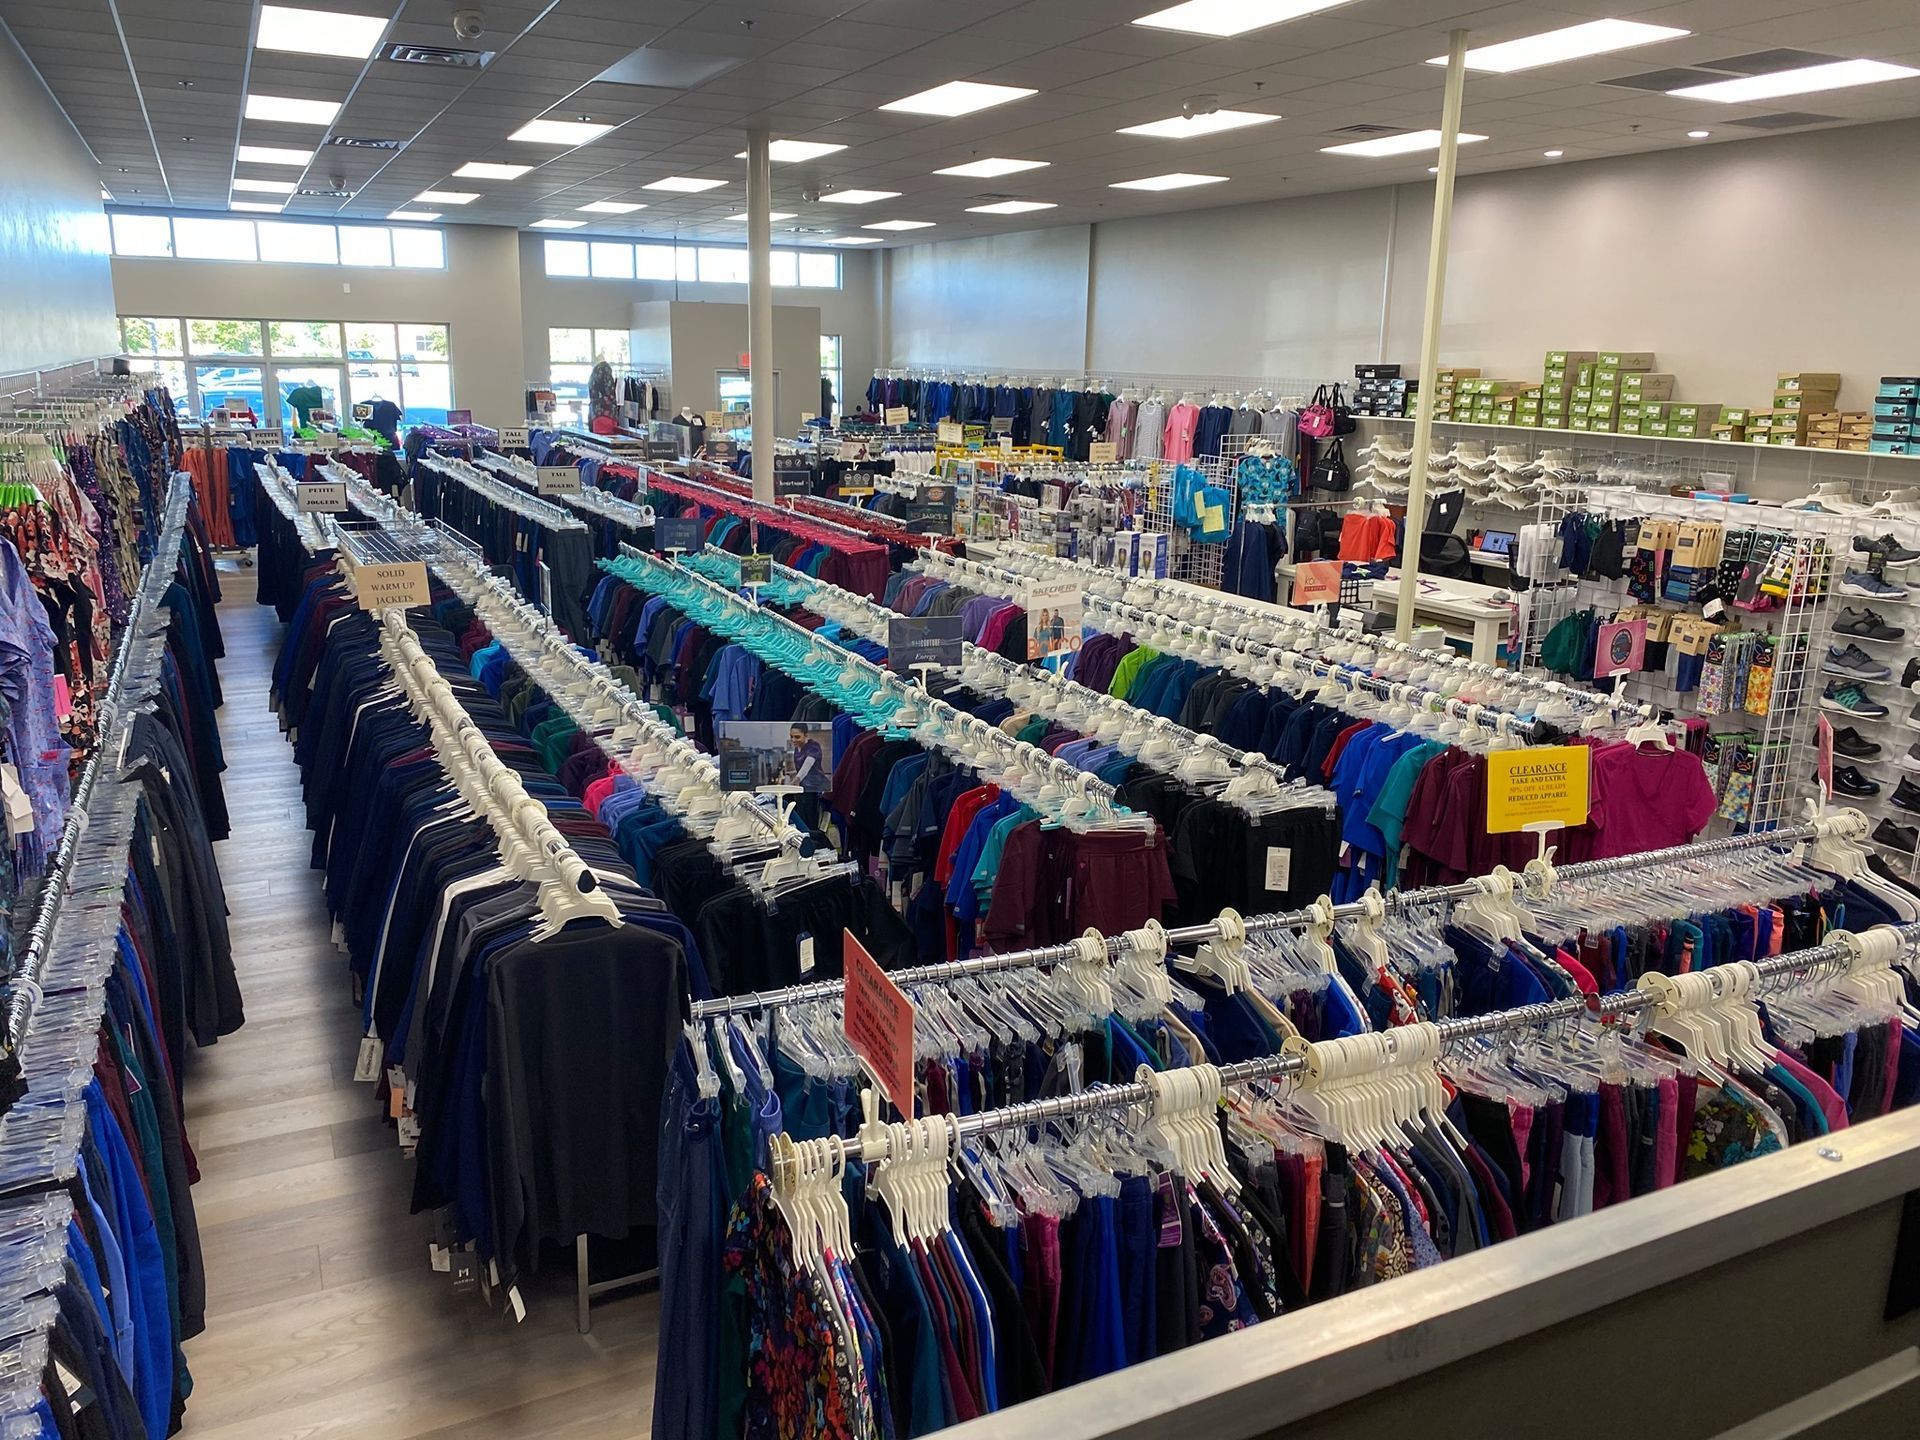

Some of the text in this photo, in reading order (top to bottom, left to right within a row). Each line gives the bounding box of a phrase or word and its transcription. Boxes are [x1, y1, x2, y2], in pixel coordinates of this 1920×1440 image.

[377, 570, 405, 578] SOLID
[371, 582, 415, 592] WARM UP
[1032, 583, 1078, 594] SKECHERS
[376, 595, 414, 605] JACKETS
[916, 652, 936, 661] Energy
[1510, 762, 1568, 775] CLEARANCE
[1508, 794, 1538, 802] REDUCED
[1838, 934, 1849, 942] XL
[856, 958, 898, 1018] CLEARANCE
[1301, 1043, 1308, 1054] M
[1143, 1069, 1148, 1078] S
[458, 1268, 468, 1278] M
